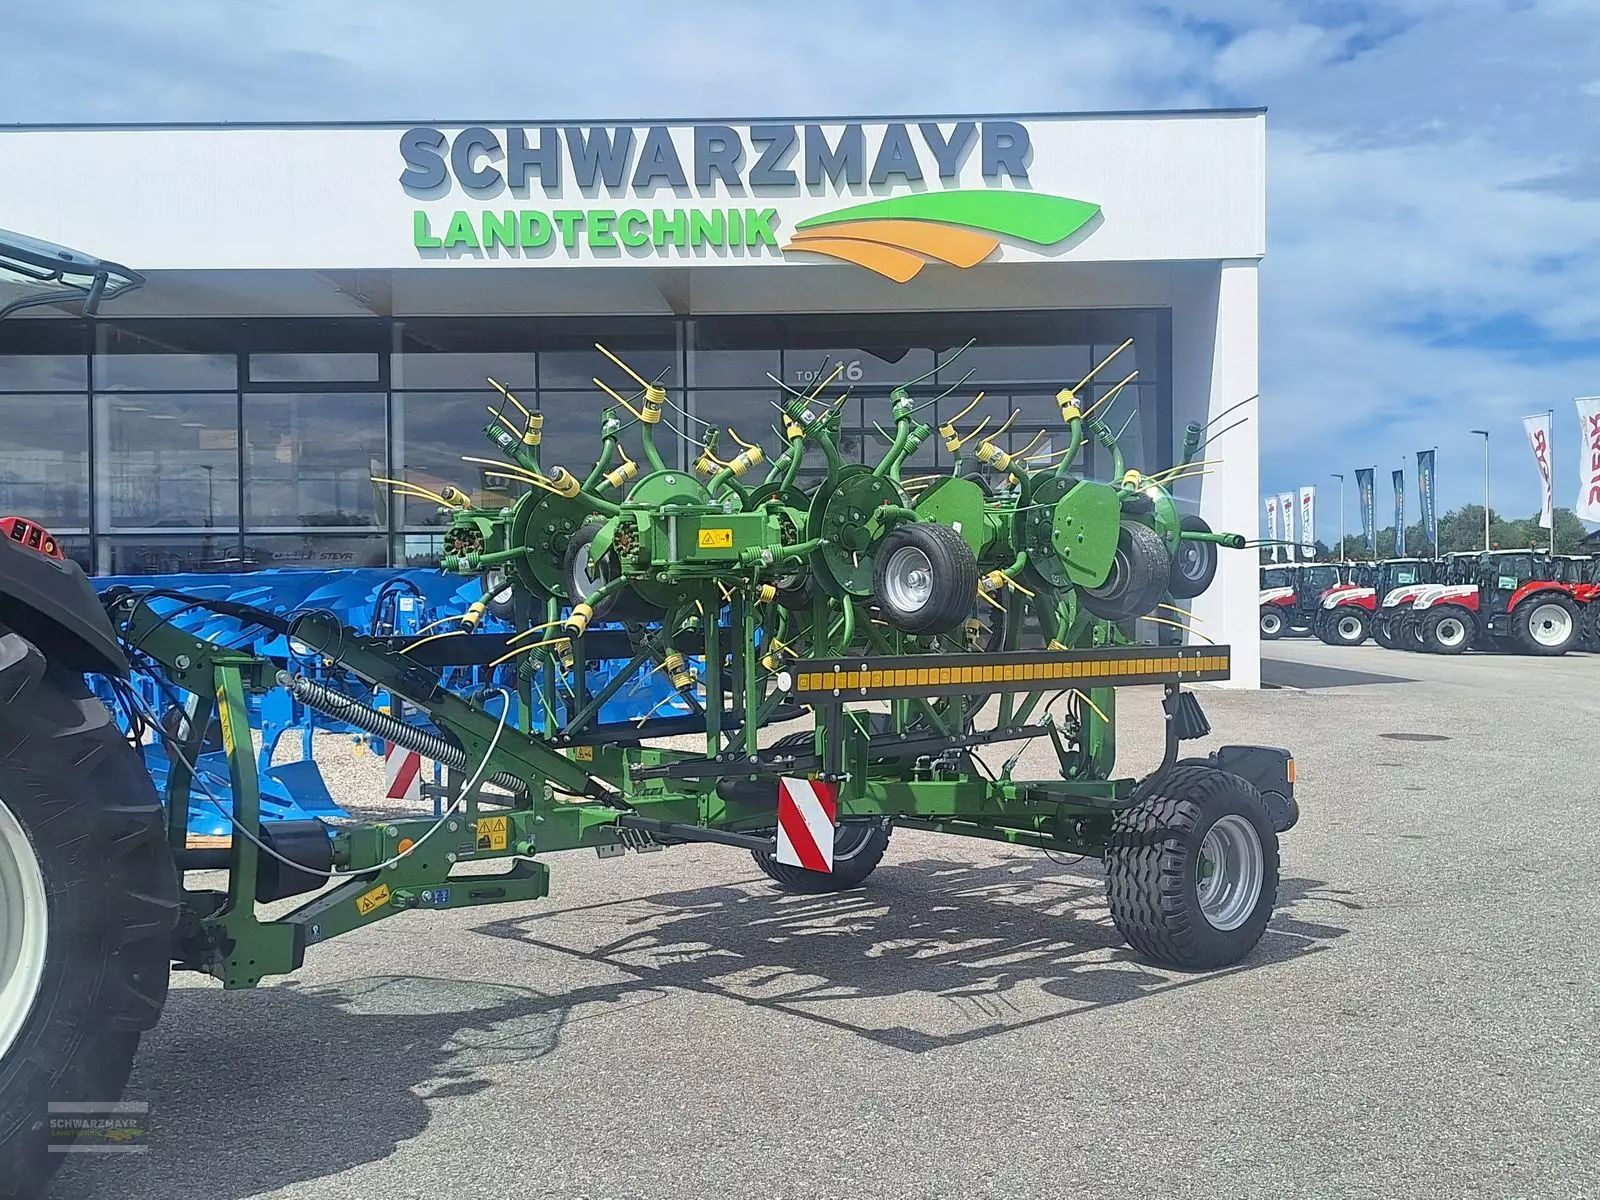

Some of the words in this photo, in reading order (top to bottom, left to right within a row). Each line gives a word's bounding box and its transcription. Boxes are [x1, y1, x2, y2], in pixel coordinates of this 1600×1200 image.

[399, 120, 1031, 190] SCHWARZMAYR
[413, 207, 778, 249] LANDTECHNIK
[835, 360, 863, 381] 16
